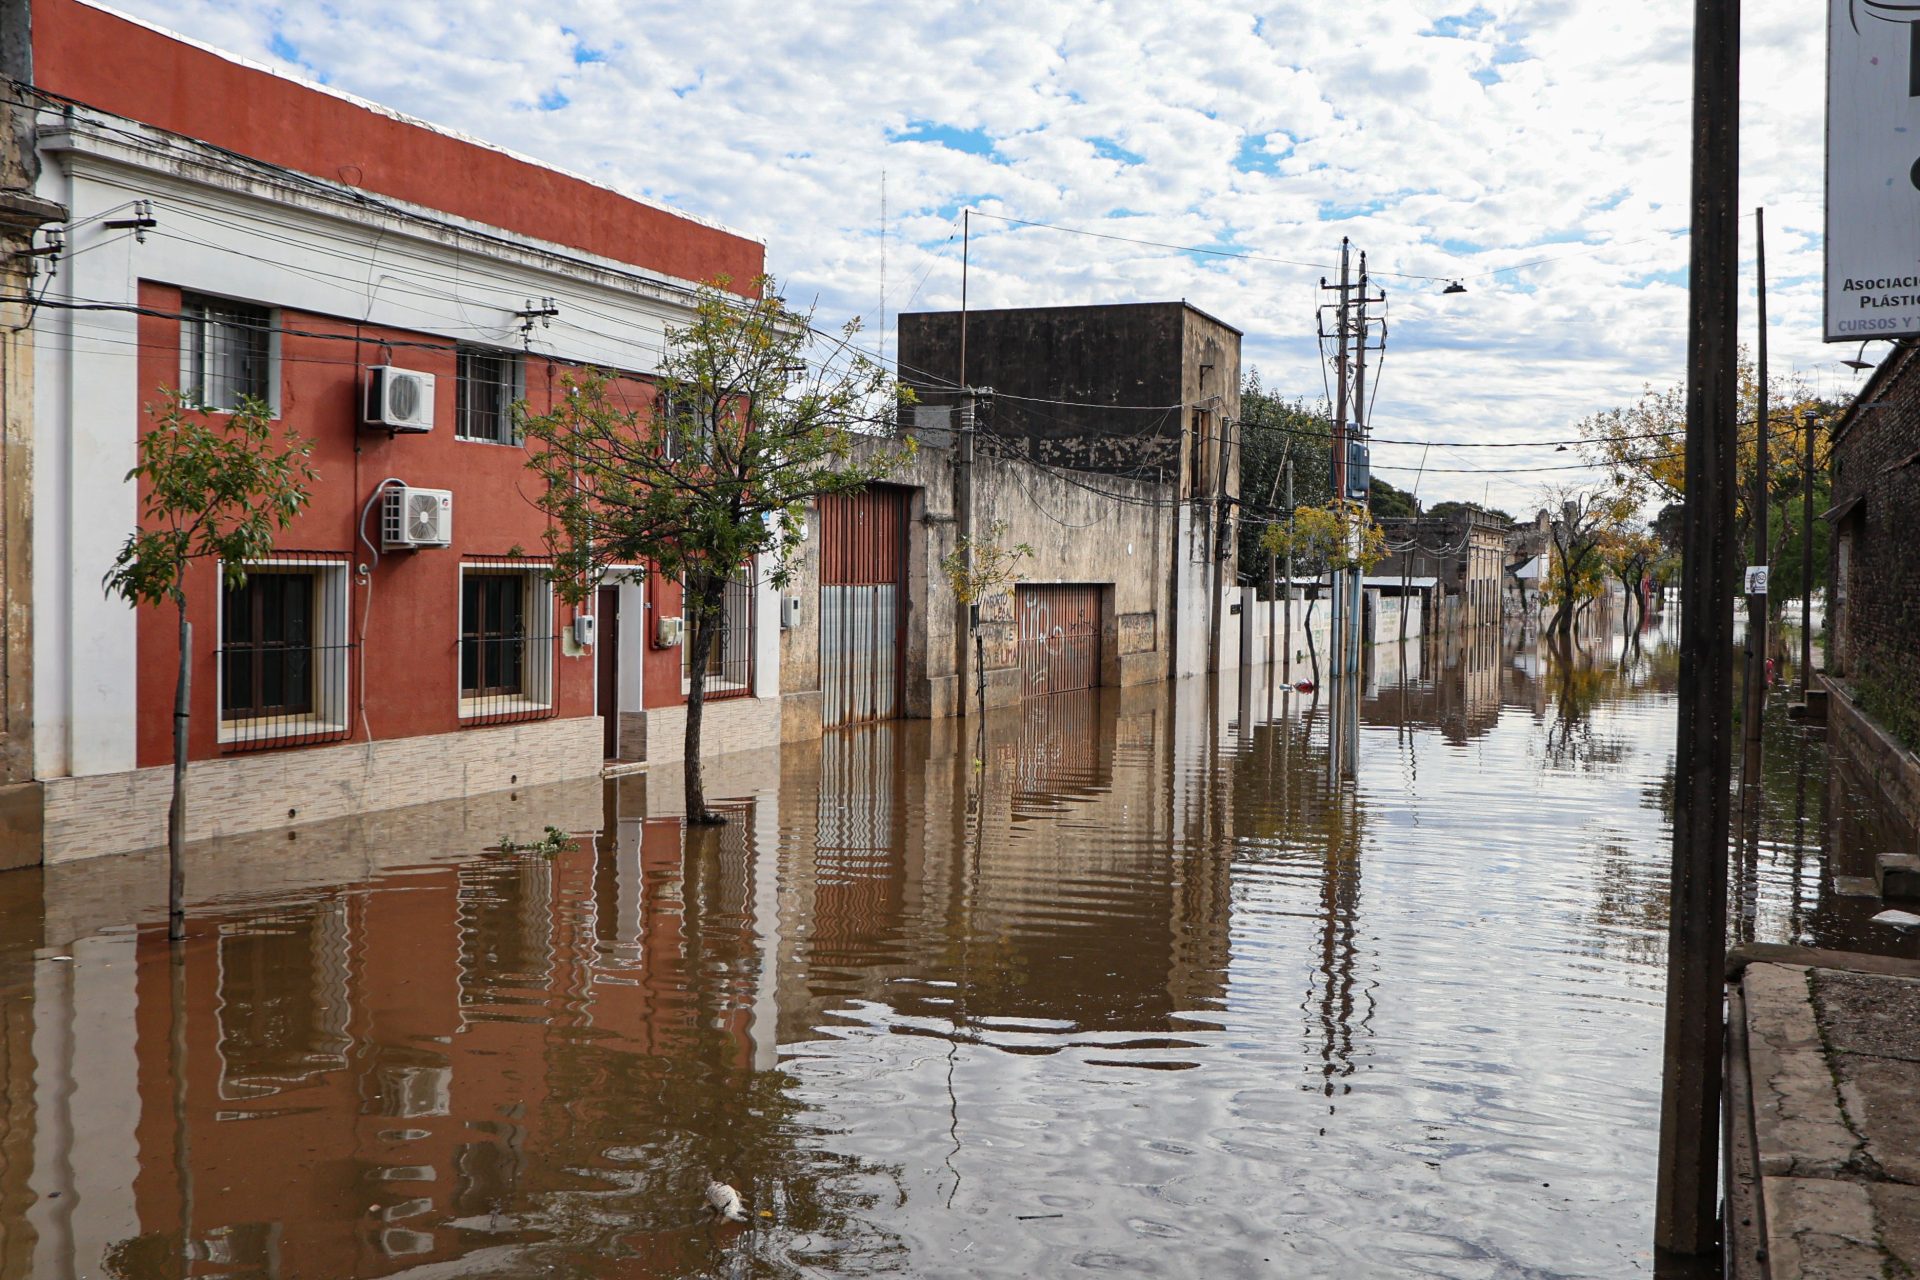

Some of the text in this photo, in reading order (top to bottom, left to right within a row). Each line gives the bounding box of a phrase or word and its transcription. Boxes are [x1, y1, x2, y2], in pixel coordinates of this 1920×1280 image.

[1843, 276, 1920, 291] ASOCIACI
[1838, 318, 1897, 332] CURSOS
[1902, 316, 1912, 328] Y
